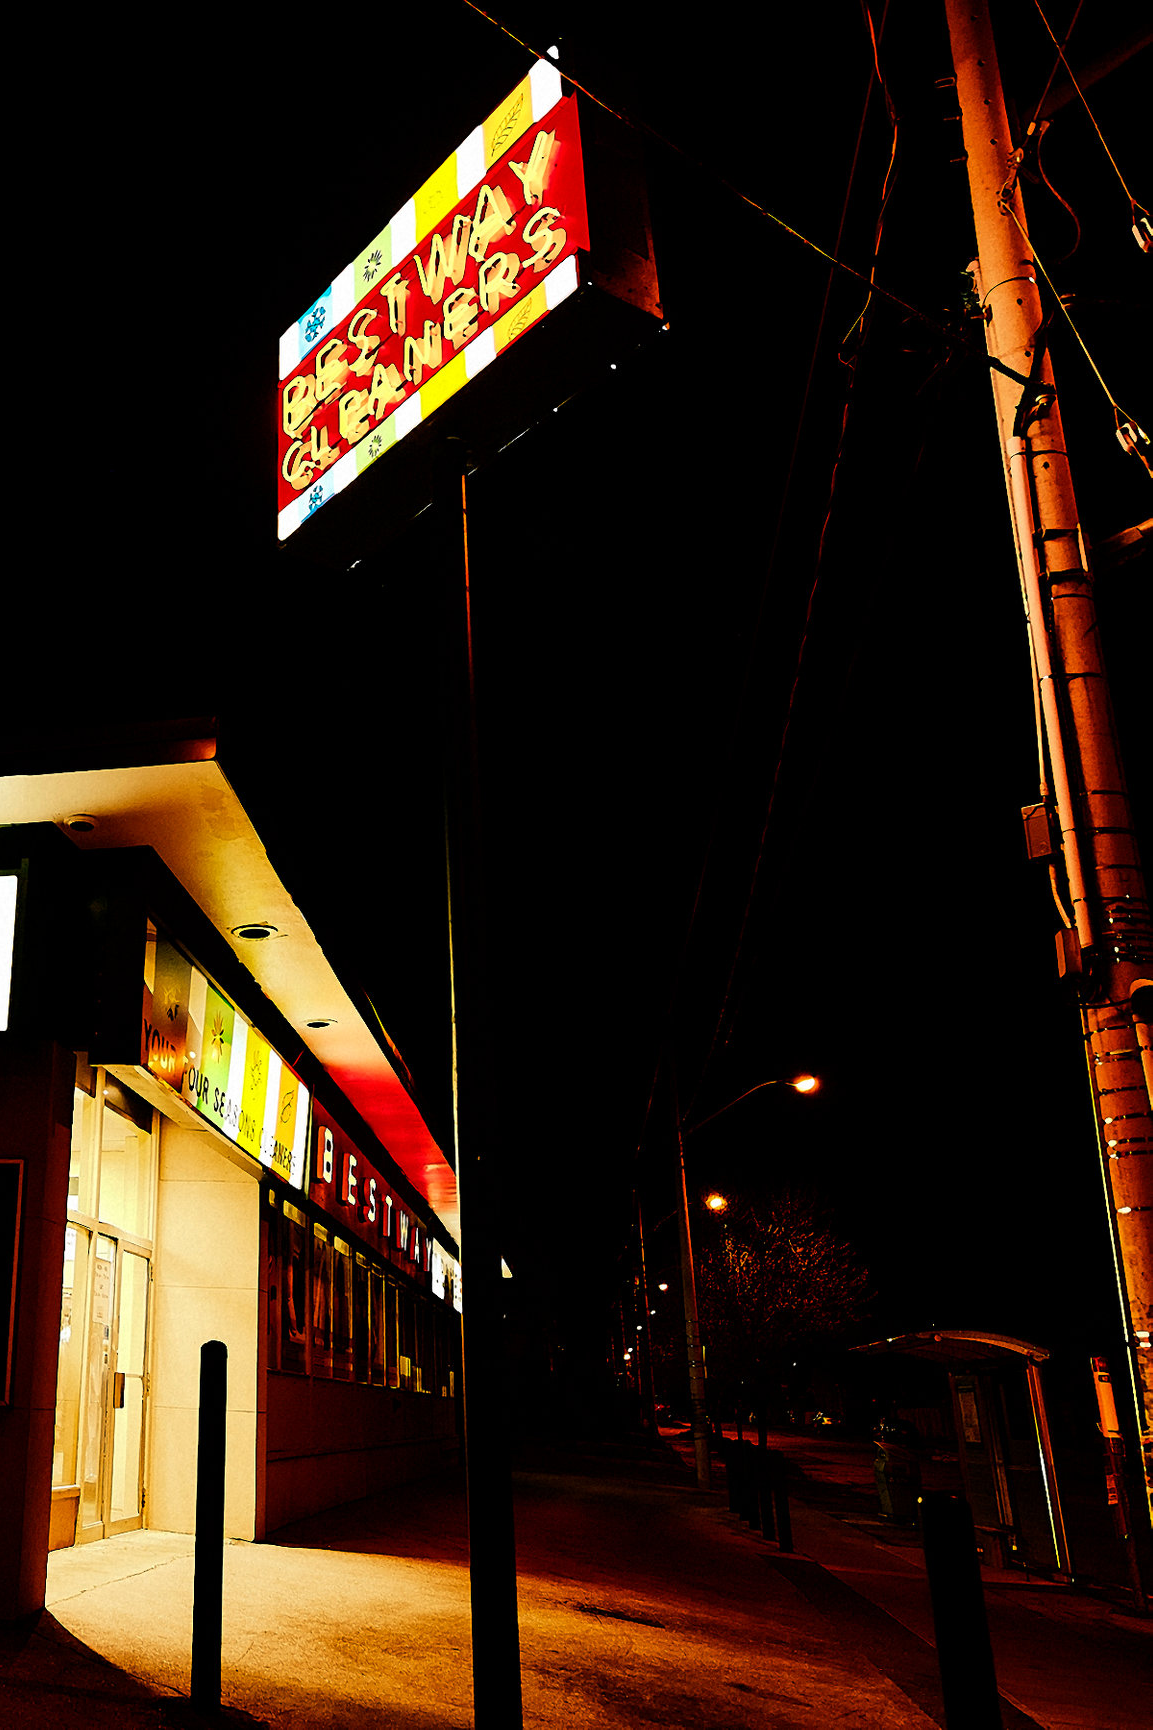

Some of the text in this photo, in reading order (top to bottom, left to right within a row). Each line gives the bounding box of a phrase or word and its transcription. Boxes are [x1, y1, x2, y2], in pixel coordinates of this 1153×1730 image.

[282, 129, 561, 438] BESTWAY
[282, 207, 567, 490] CLEANERS
[259, 1127, 296, 1175] CANERS
[317, 1125, 432, 1272] BESTWAY
